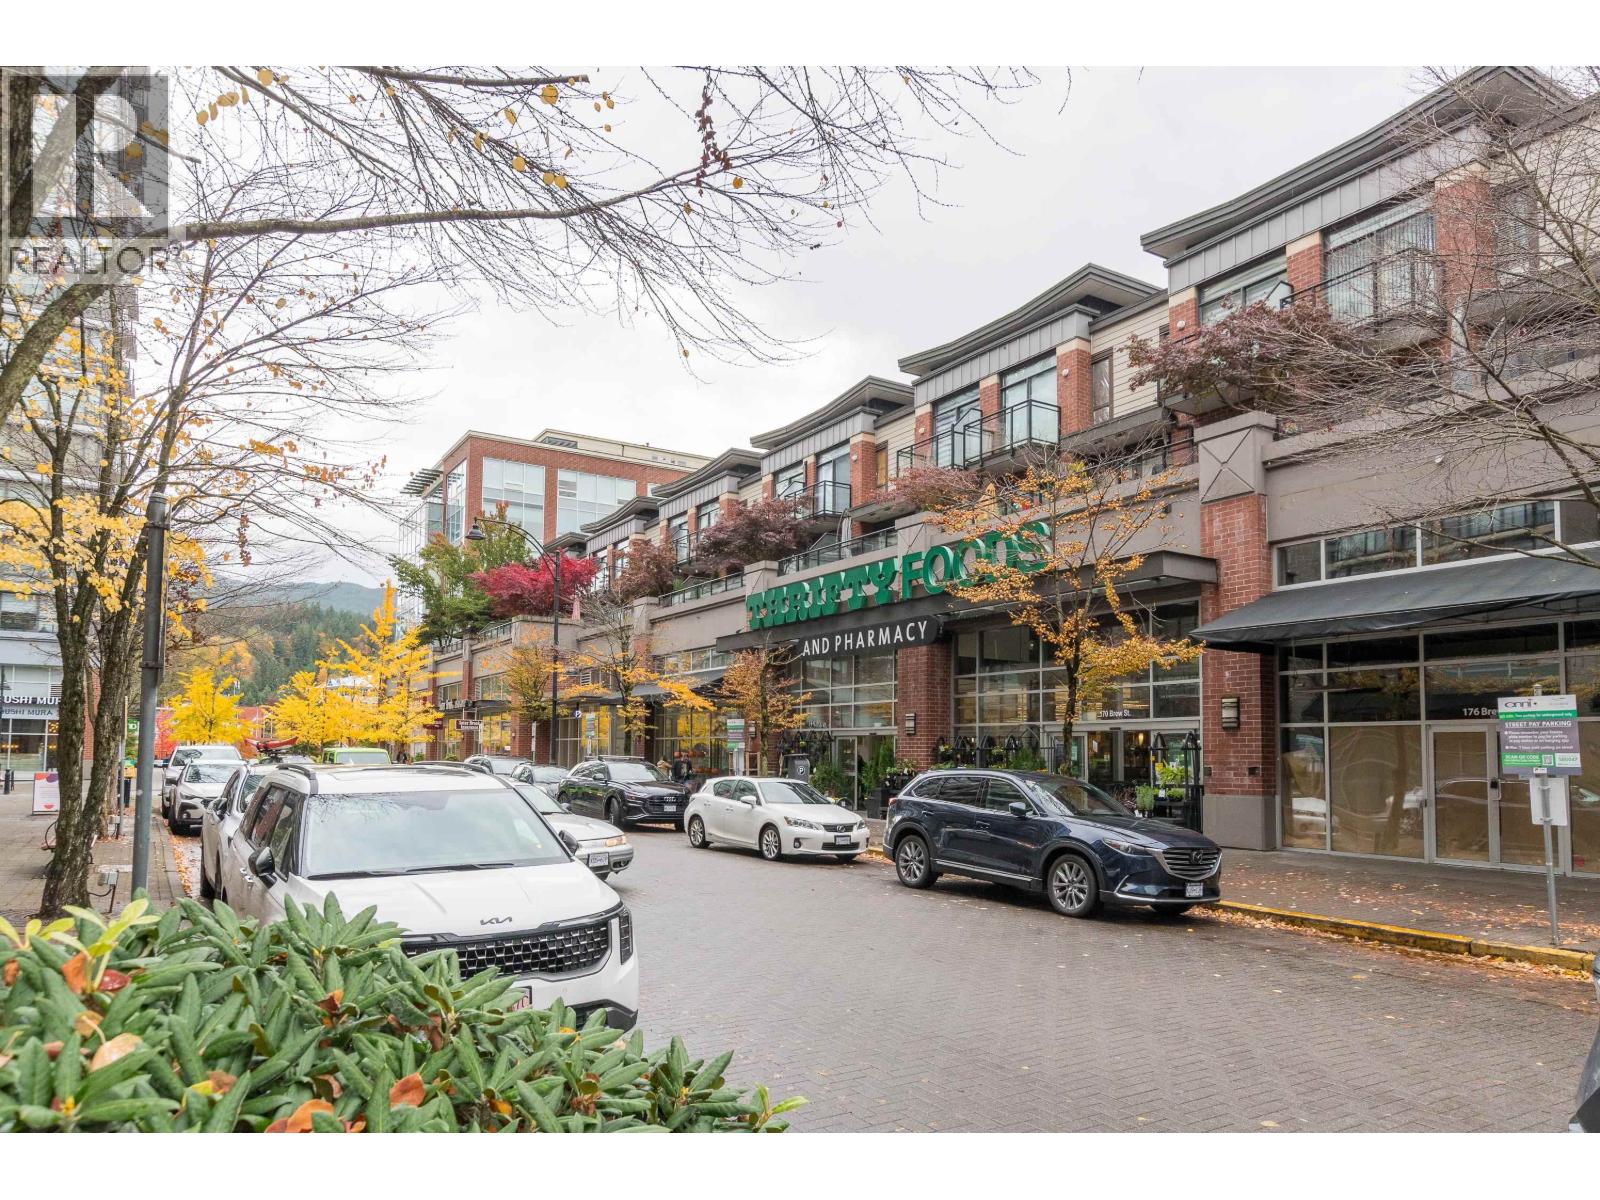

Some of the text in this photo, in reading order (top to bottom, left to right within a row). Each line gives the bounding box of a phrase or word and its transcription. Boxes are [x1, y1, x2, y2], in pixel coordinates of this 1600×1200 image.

[746, 521, 1052, 630] THRIFTY FOODS
[802, 621, 928, 657] AND PHARMACY
[0, 696, 32, 704] USHI
[1462, 707, 1498, 716] 176 Bre
